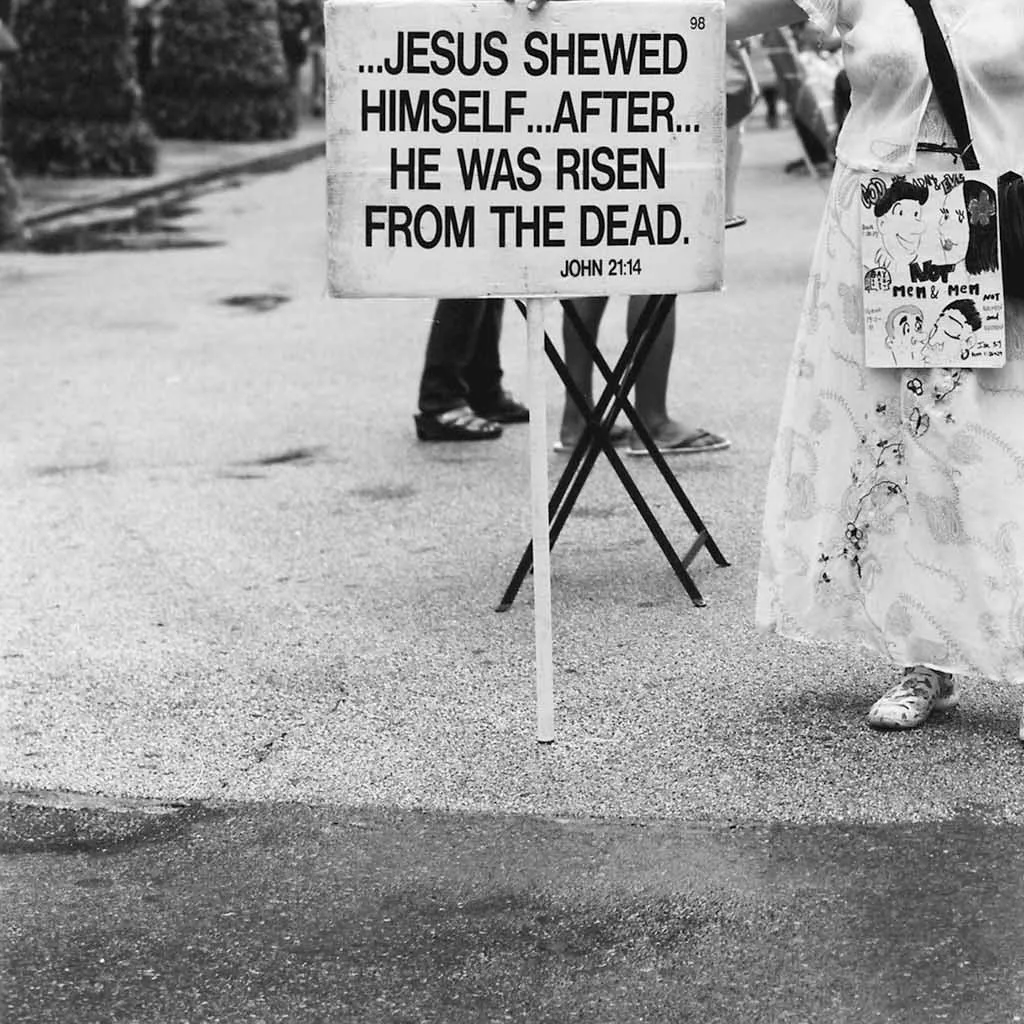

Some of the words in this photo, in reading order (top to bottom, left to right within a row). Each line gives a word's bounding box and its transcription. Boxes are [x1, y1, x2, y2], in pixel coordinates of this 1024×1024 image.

[690, 17, 705, 30] 98
[524, 31, 687, 76] SHEWED
[391, 148, 440, 190] HE
[457, 147, 541, 191] WAS
[557, 146, 665, 191] RISEN
[366, 204, 474, 249] FROM
[490, 206, 565, 247] THE
[580, 204, 688, 246] DEAD.
[561, 259, 602, 277] JOHN
[609, 259, 641, 275] 21:14
[930, 285, 939, 299] &
